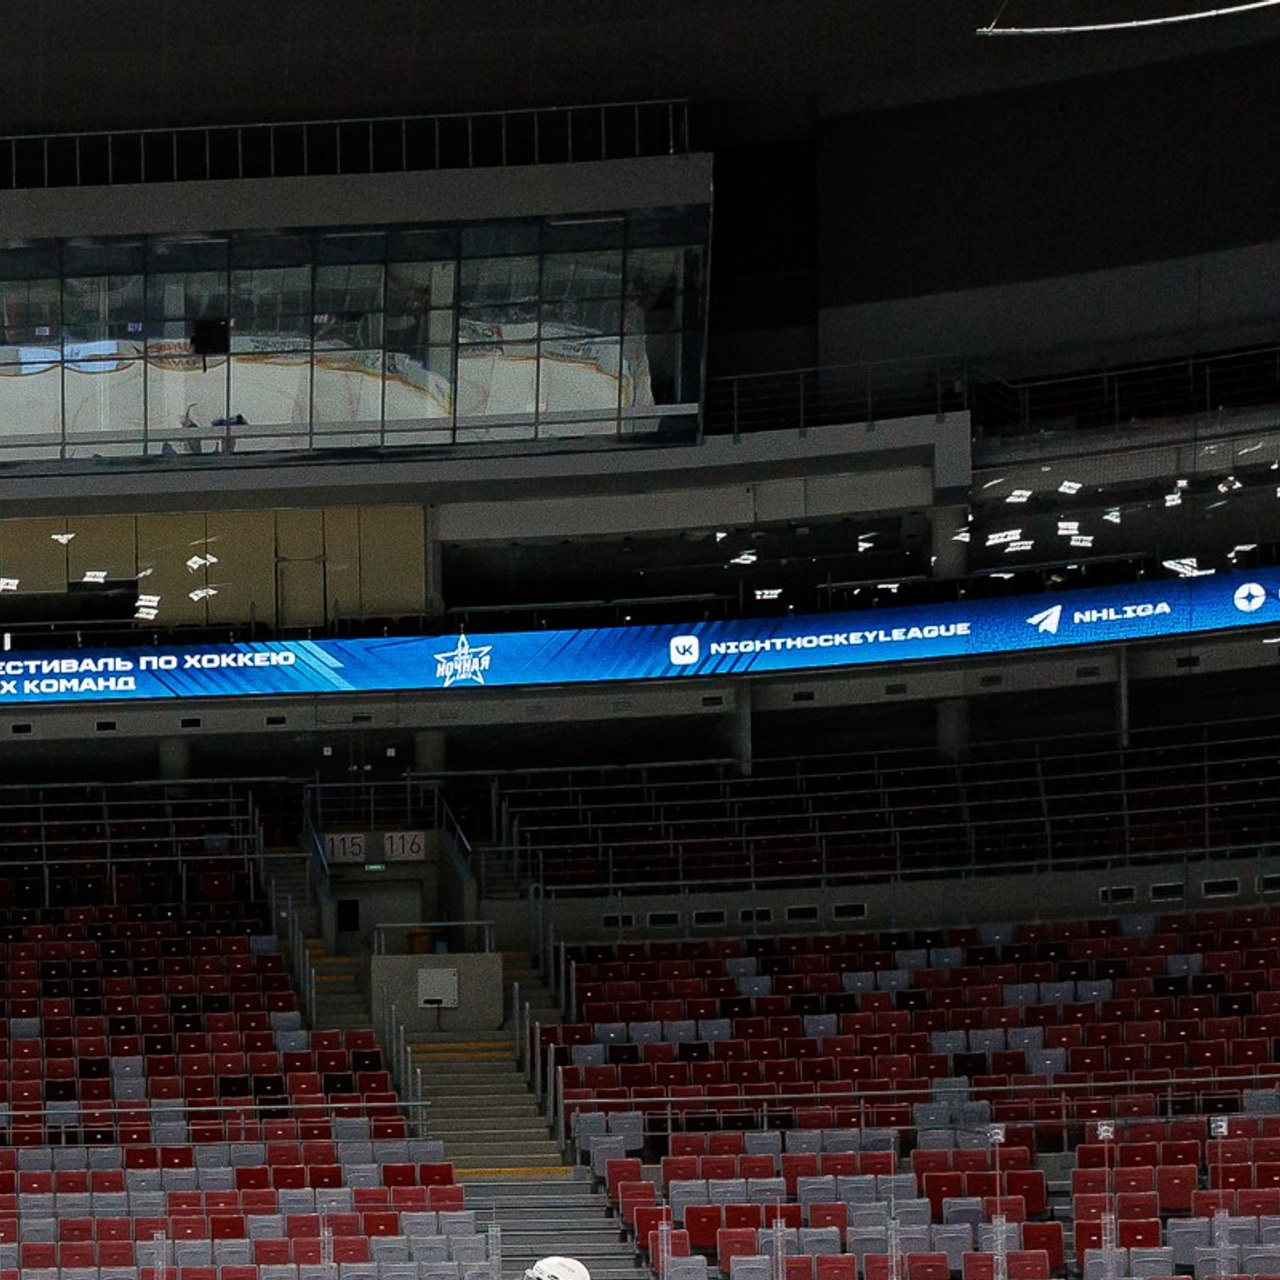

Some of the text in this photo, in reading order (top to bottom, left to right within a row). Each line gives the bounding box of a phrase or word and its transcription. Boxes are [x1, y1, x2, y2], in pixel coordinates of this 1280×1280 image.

[1073, 602, 1171, 624] NHLIGA
[710, 622, 972, 655] NIGHTHOCKEYLEAGUE
[139, 655, 178, 670] ПО
[183, 651, 296, 669] ХОККЕЮ
[23, 675, 137, 694] КОМАНД
[327, 835, 363, 857] 115
[385, 833, 422, 855] 116
